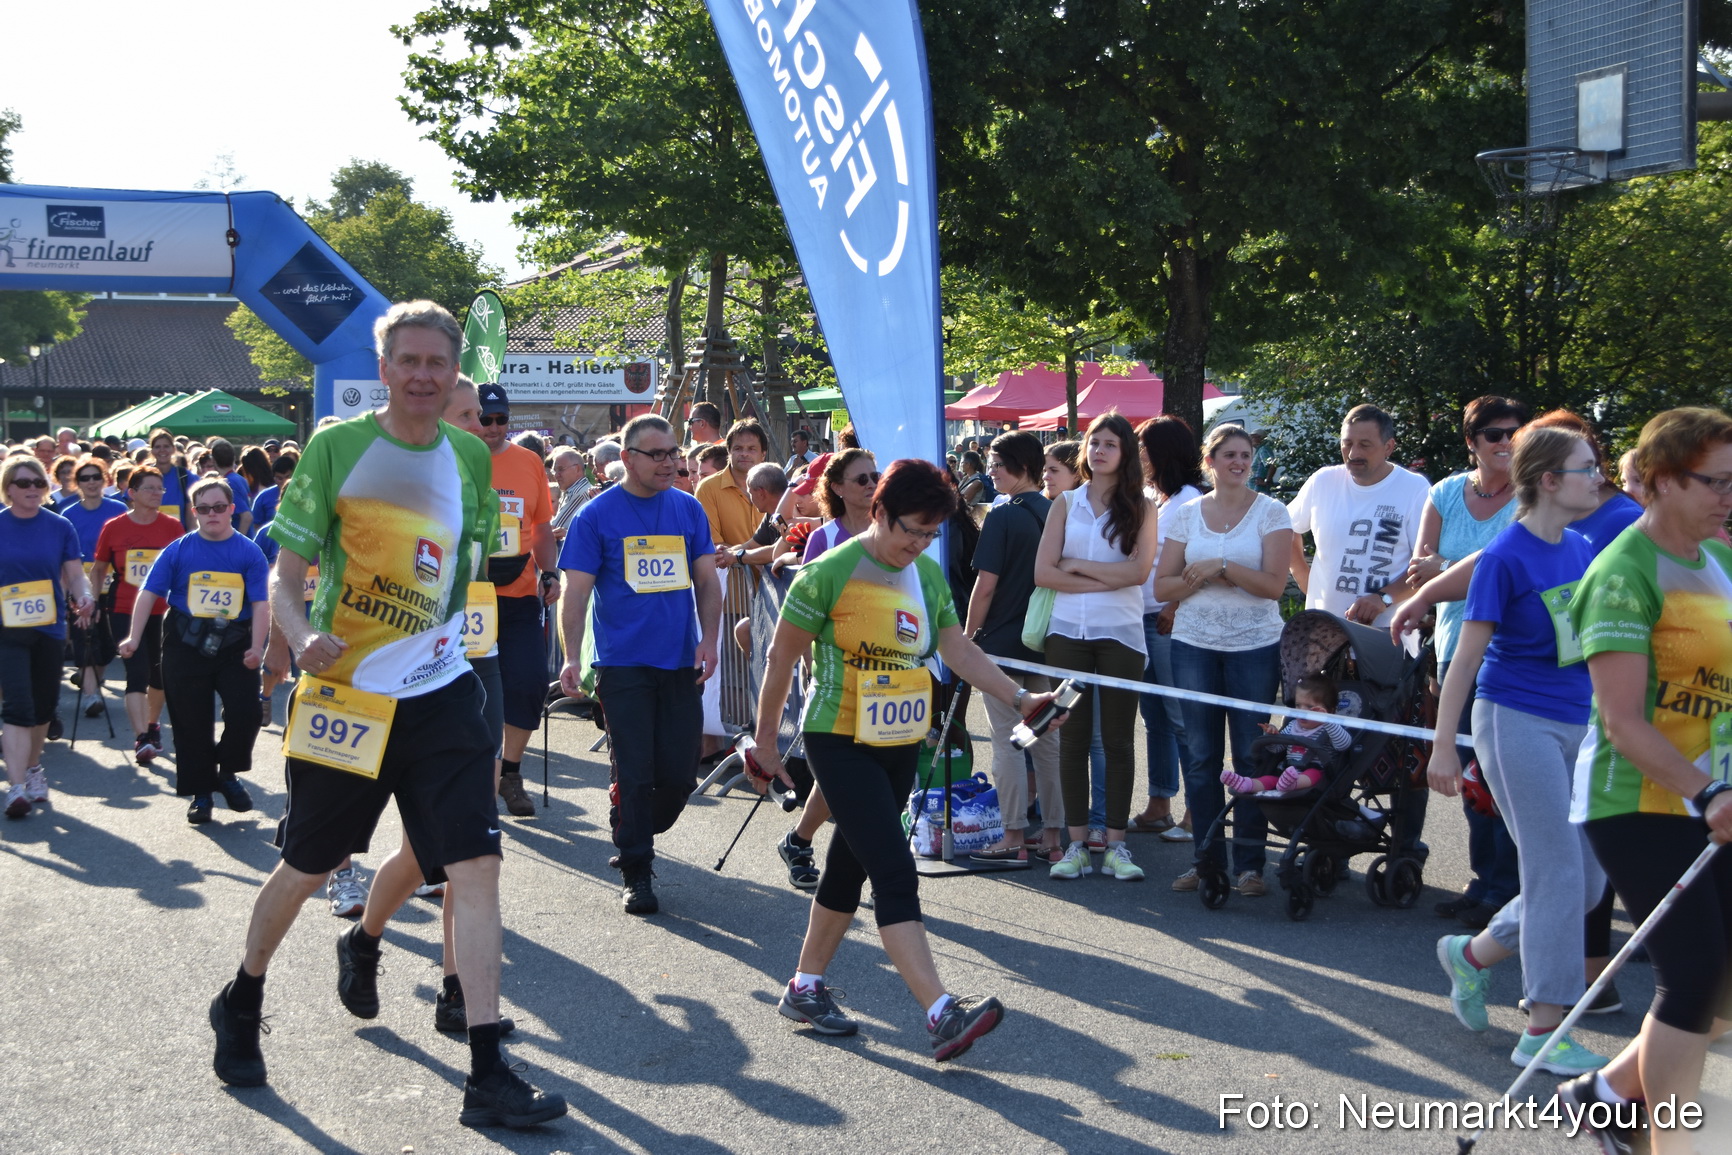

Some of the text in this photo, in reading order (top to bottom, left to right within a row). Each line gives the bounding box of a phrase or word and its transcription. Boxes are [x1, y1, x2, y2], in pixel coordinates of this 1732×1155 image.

[59, 217, 102, 227] Fischer
[28, 237, 154, 262] firmenlauf
[26, 260, 80, 269] neumarkt
[283, 285, 300, 295] und
[302, 284, 319, 293] das
[500, 362, 530, 374] ura
[548, 360, 614, 374] Halen
[567, 381, 584, 389] grüßt
[497, 487, 515, 496] ahre
[500, 501, 520, 513] BI
[273, 520, 306, 543] msbraeu.de
[286, 518, 309, 534] Genuss
[501, 530, 509, 546] 1
[1335, 519, 1373, 595] BFLD
[1363, 518, 1402, 594] ENIM
[131, 564, 151, 577] 10
[637, 558, 676, 577] 802
[200, 589, 232, 606] 743
[12, 598, 46, 616] 766
[1593, 620, 1616, 630] leben.
[1692, 665, 1732, 697] Neu
[867, 698, 926, 726] 1000
[309, 713, 370, 749] 997
[927, 797, 939, 805] 36
[953, 821, 981, 834] Coors
